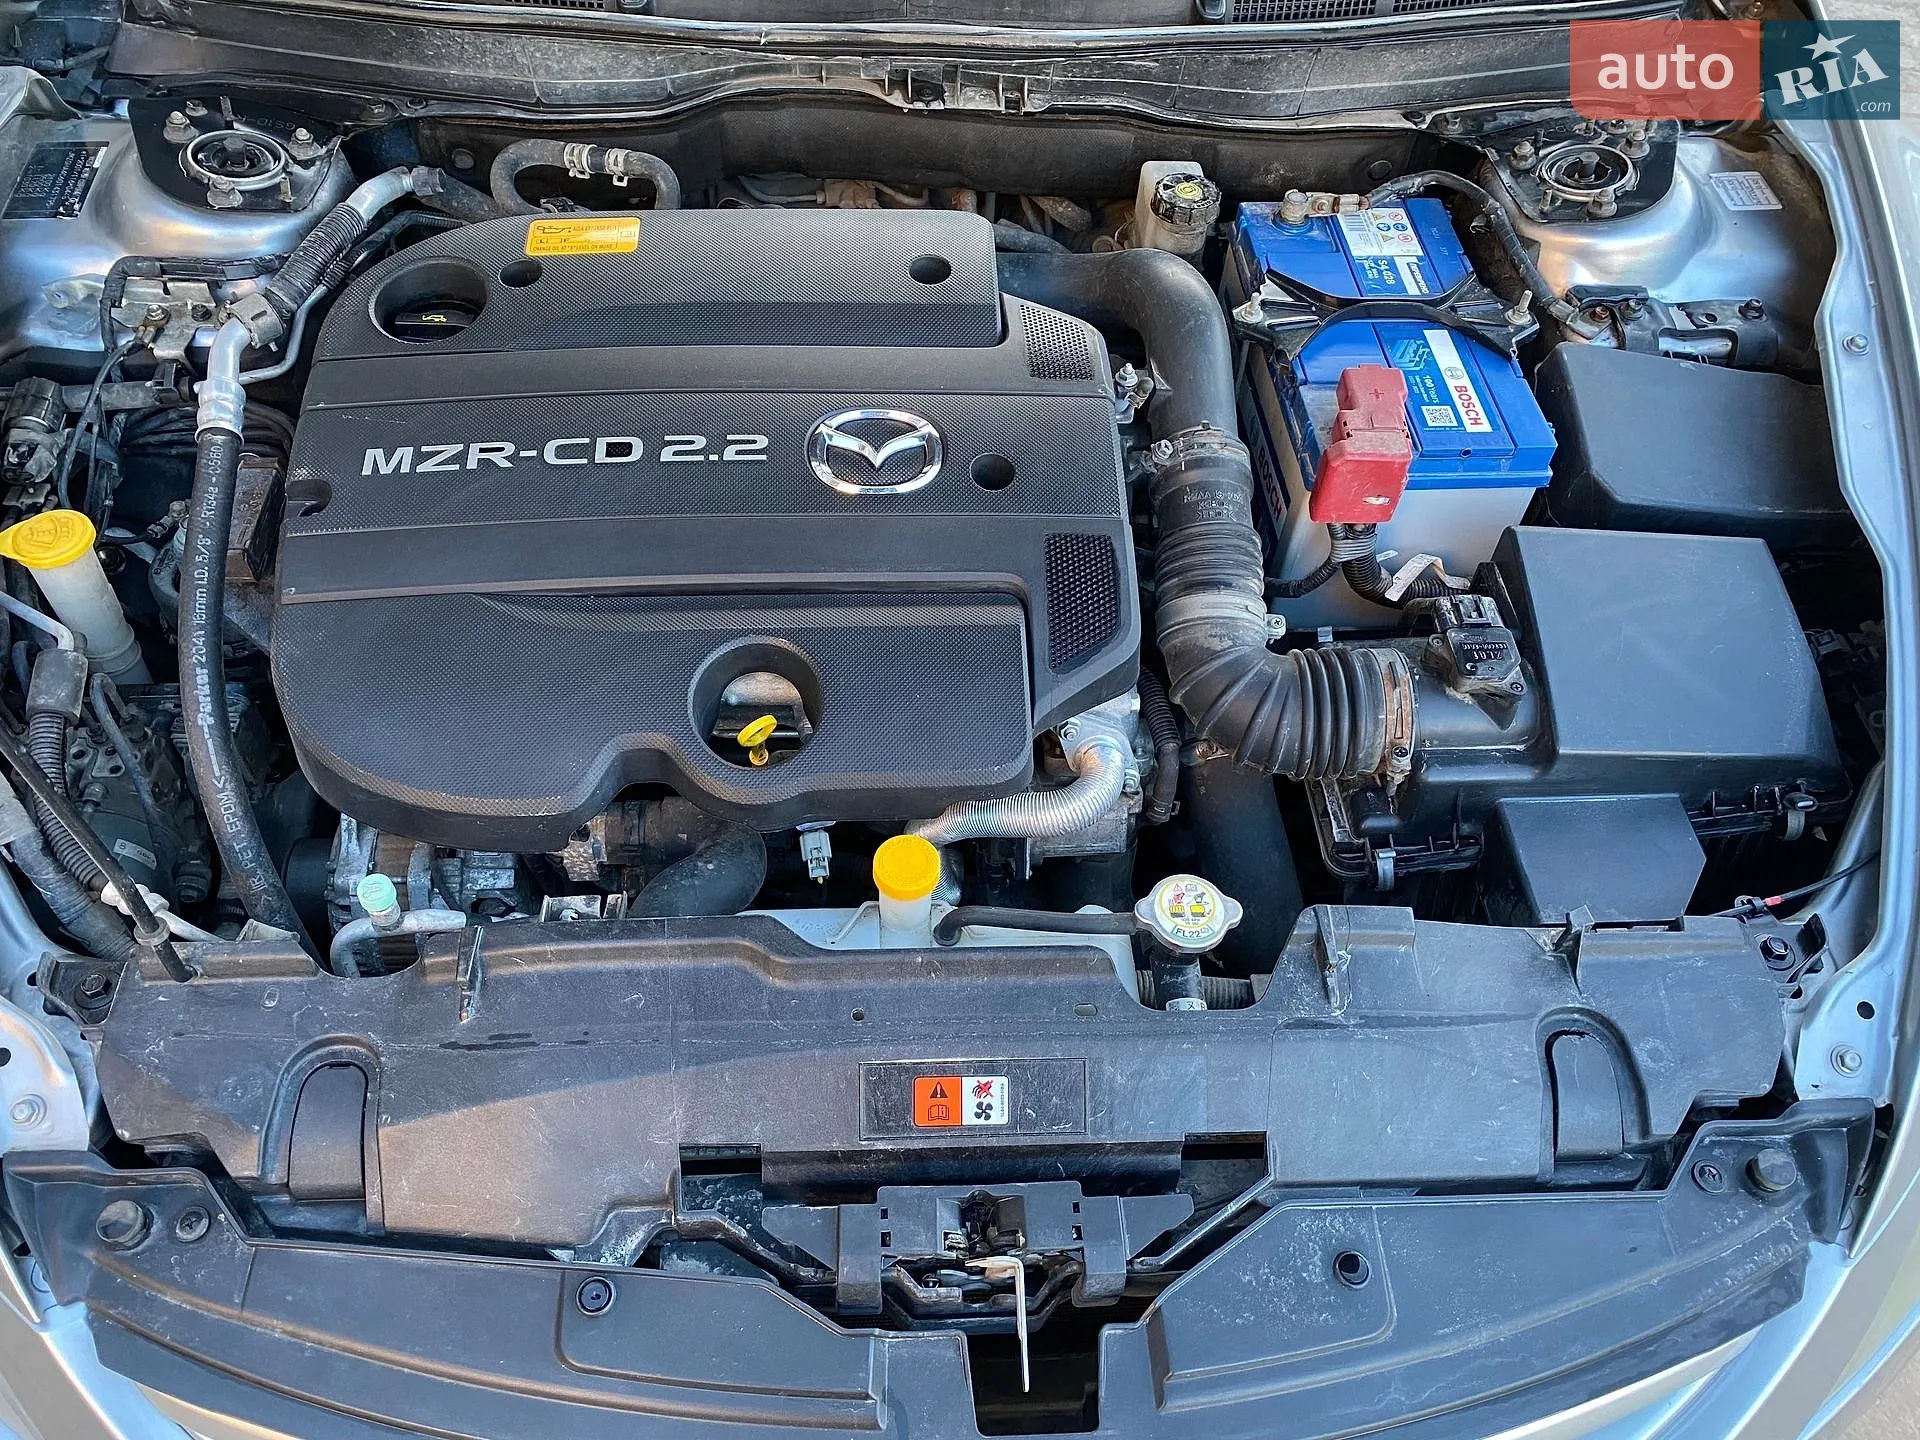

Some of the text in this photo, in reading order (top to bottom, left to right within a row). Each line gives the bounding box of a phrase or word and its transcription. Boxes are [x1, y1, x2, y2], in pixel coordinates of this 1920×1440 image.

[1423, 375, 1440, 403] 100 Years
[1453, 385, 1484, 426] BOSCH
[361, 434, 769, 476] MZR-CD 2.2
[1258, 446, 1282, 522] BOSCH
[195, 668, 214, 726] Parker
[1175, 928, 1201, 938] FL22
